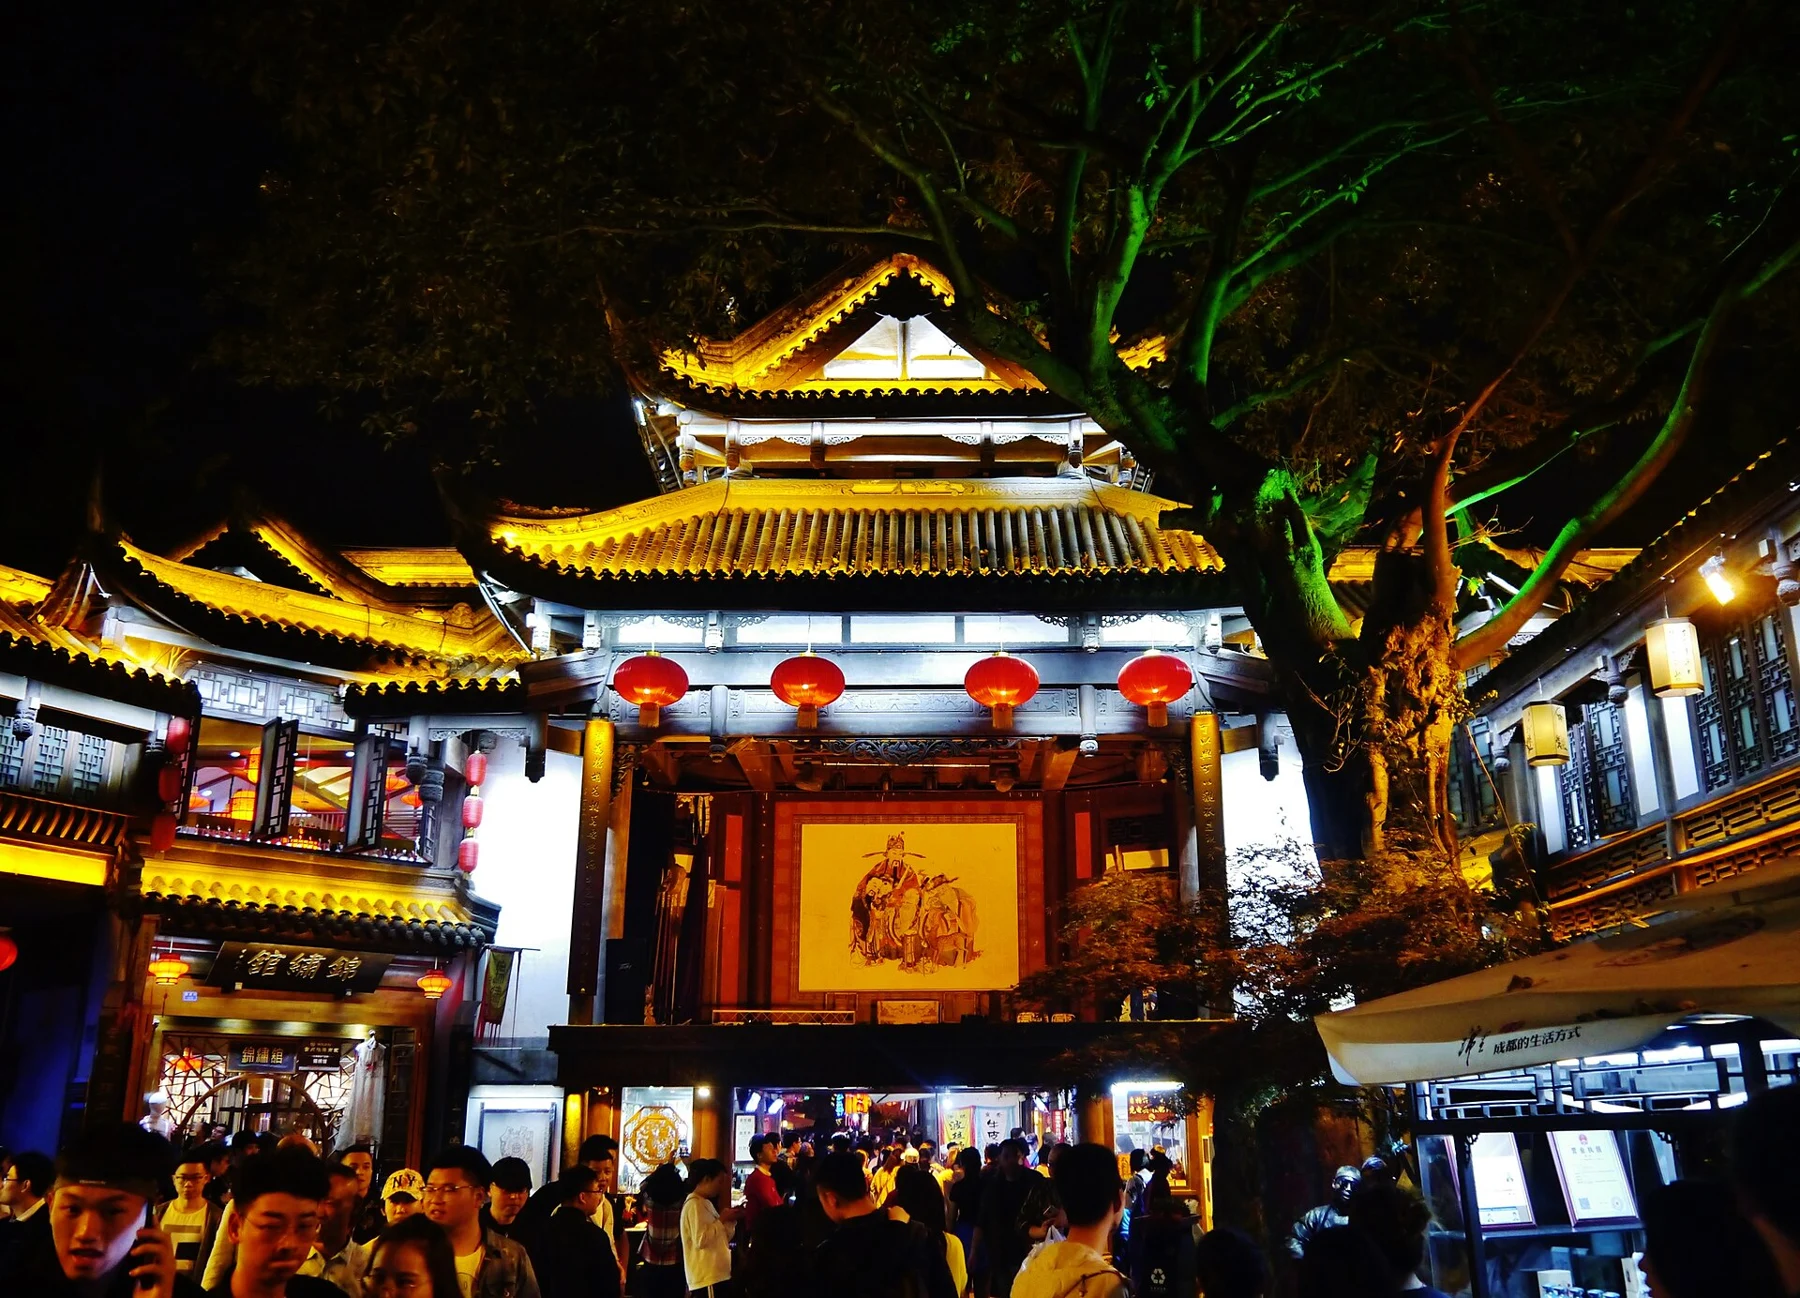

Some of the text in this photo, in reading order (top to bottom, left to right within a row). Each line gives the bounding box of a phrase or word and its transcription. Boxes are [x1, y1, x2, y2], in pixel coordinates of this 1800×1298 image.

[1493, 1026, 1581, 1055] 成都的生活方式
